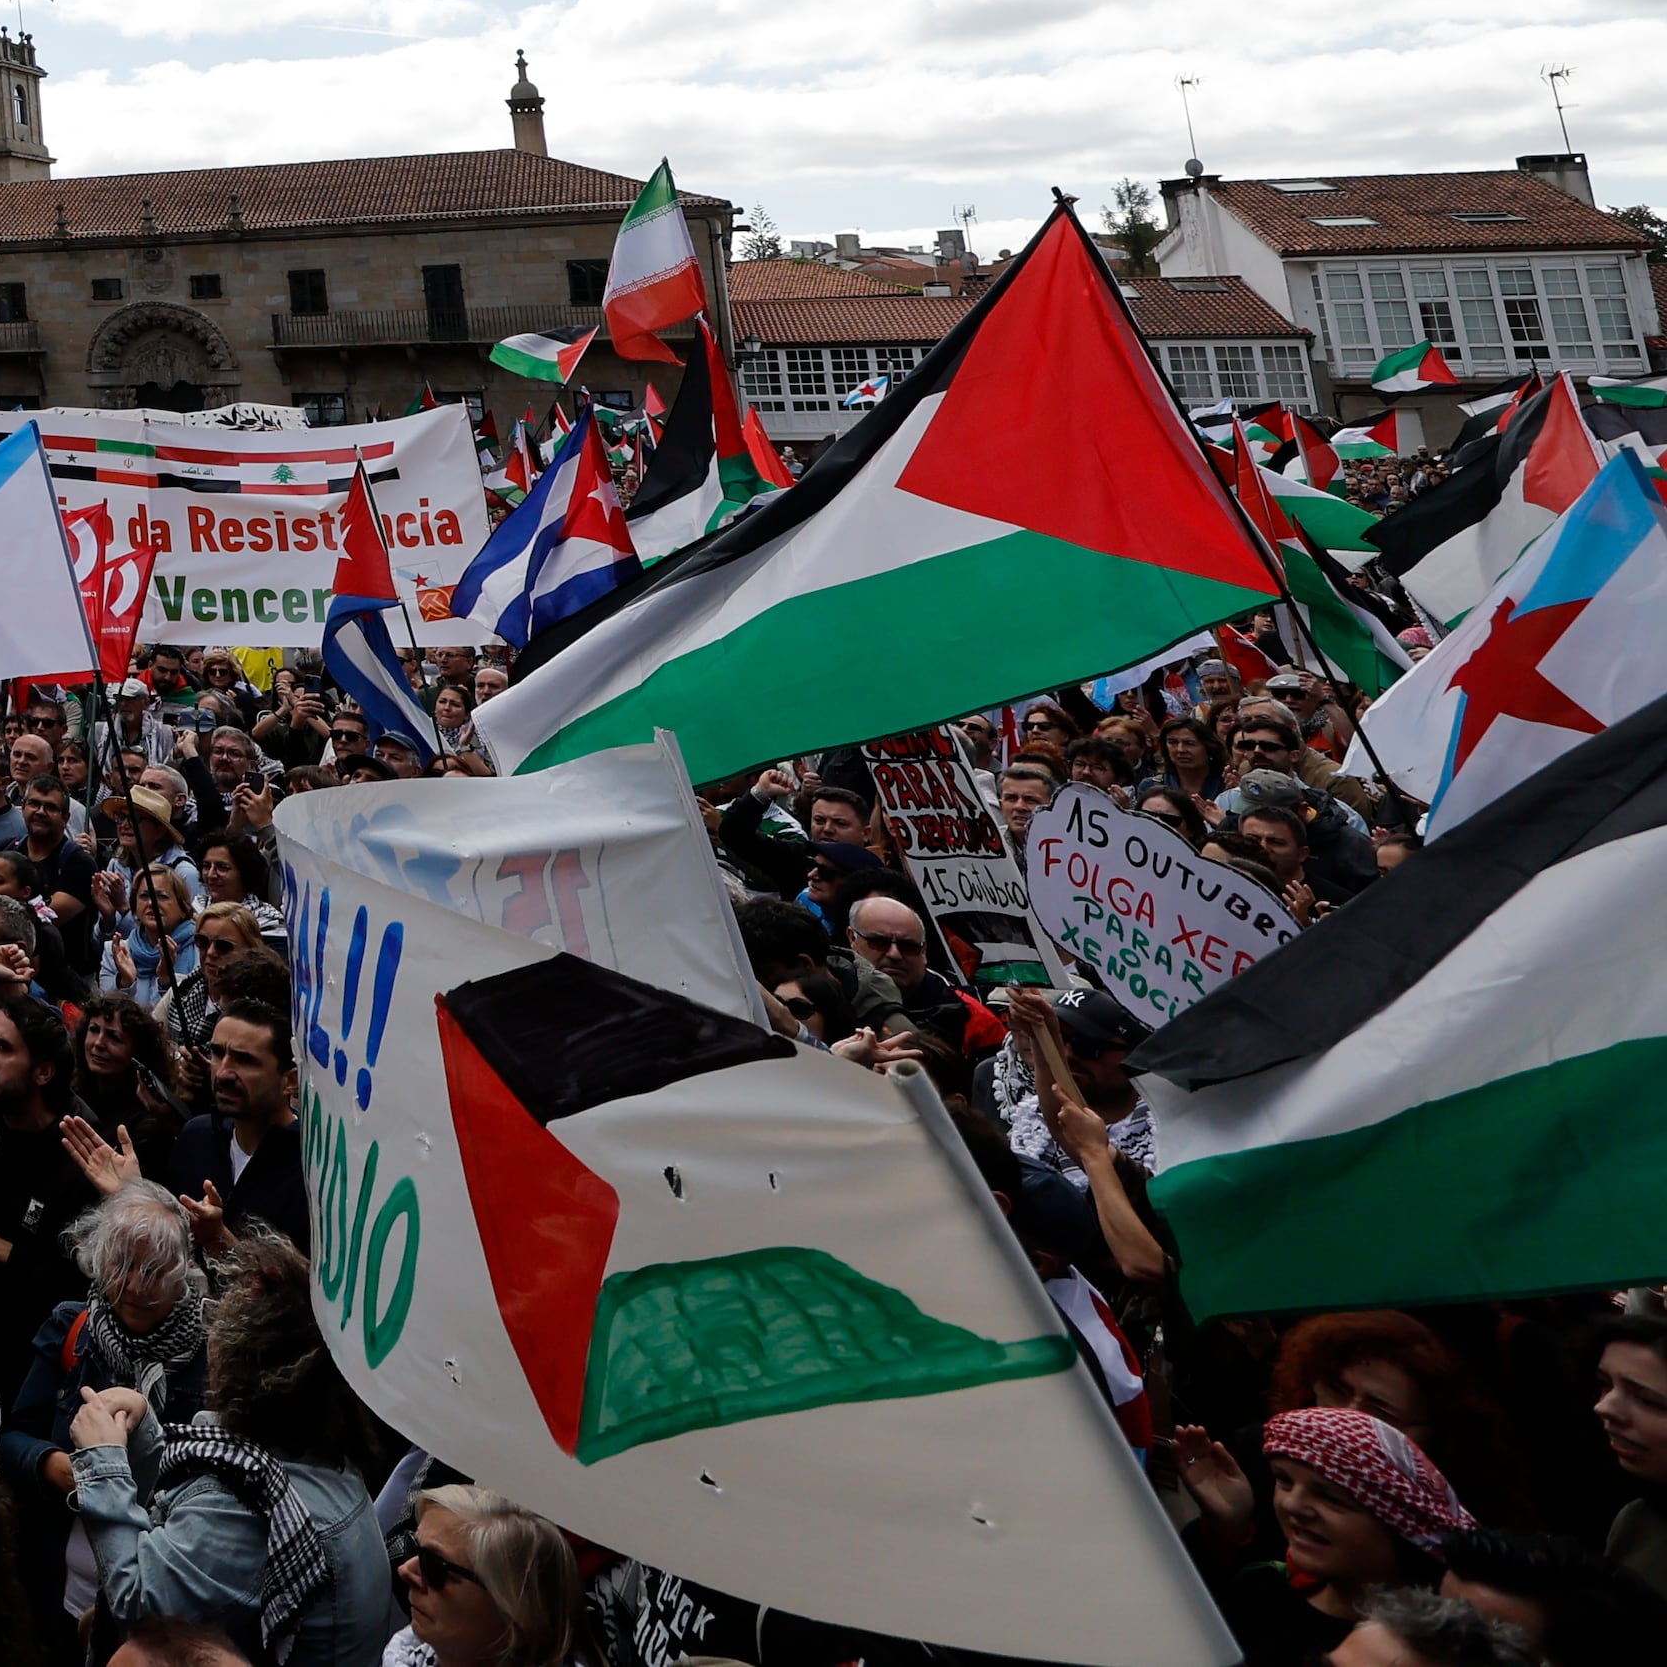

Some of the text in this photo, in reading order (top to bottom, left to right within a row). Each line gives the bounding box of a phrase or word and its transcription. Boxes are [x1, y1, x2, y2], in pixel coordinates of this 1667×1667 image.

[873, 761, 977, 812] PARAR
[1066, 797, 1110, 848] 15
[922, 866, 960, 908] 15
[1038, 838, 1156, 929] FOLGA
[1060, 917, 1197, 1020] XENOCI
[1073, 895, 1206, 996] PARAR
[1119, 948, 1142, 970] O
